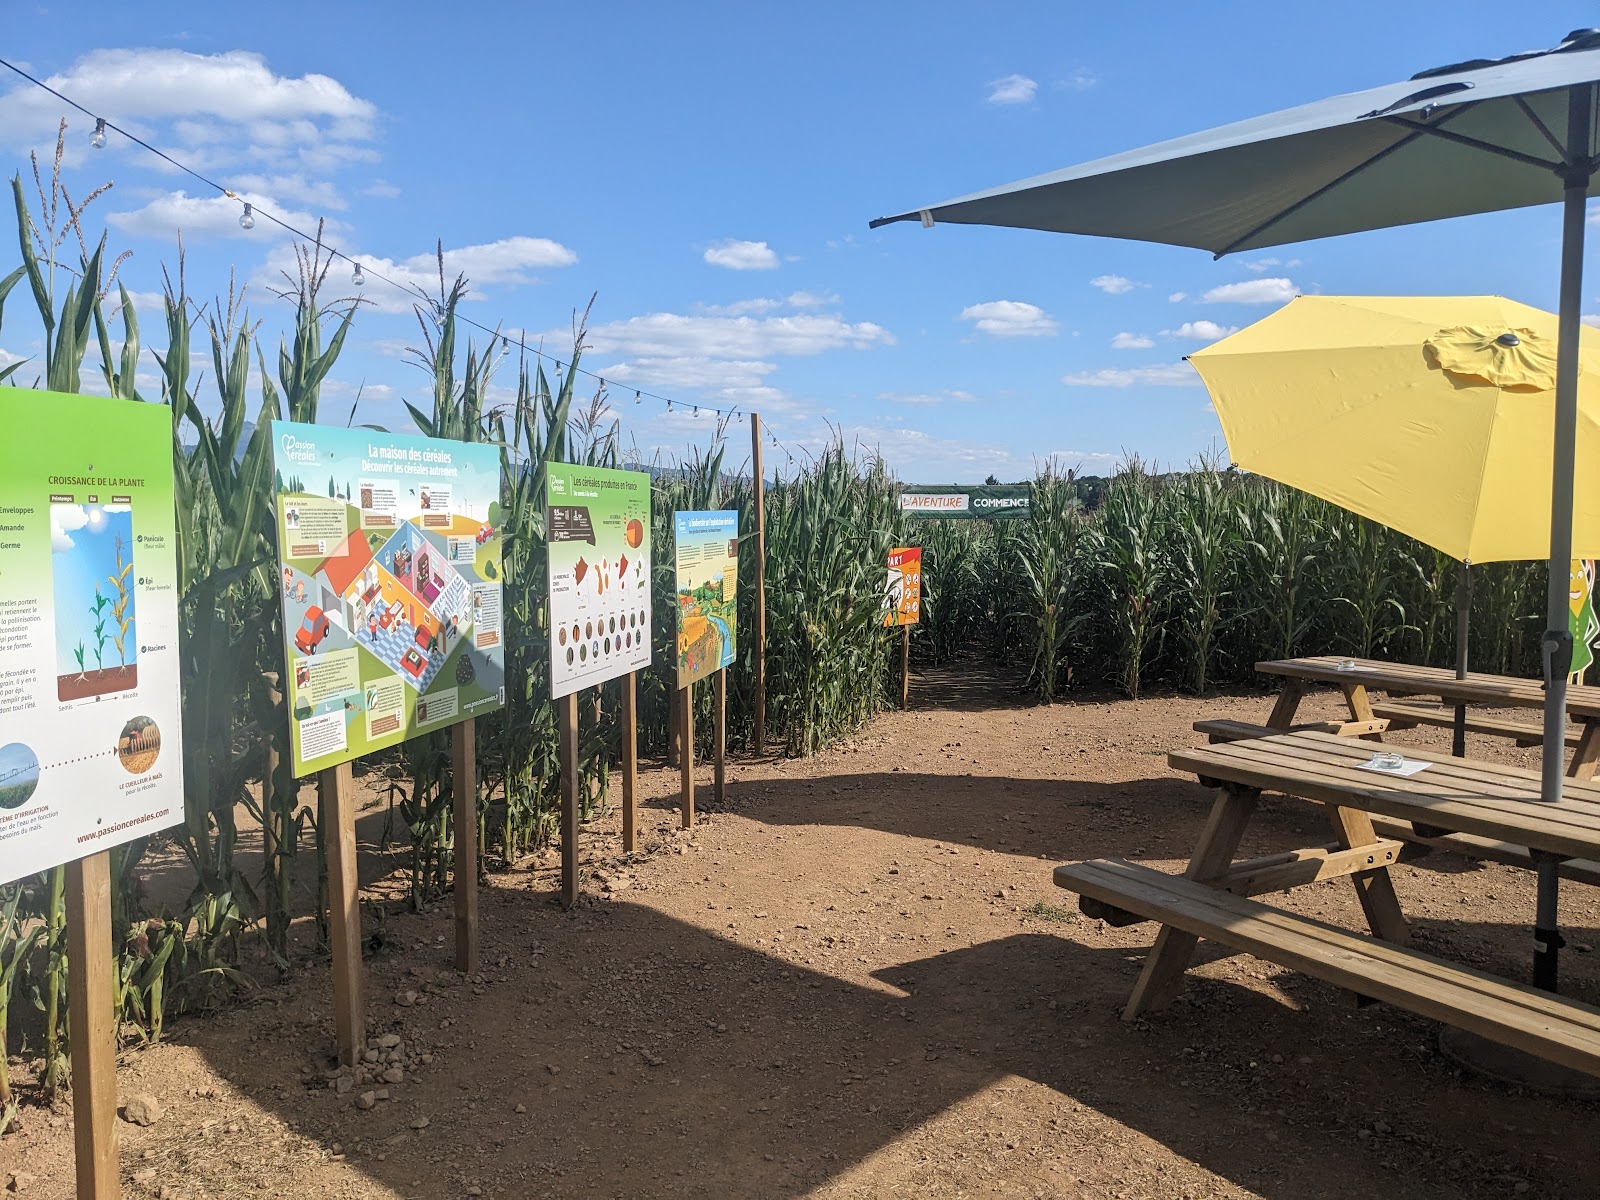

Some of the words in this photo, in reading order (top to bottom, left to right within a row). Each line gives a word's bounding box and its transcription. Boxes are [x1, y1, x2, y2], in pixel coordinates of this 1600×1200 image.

[287, 435, 316, 450] Passion
[368, 443, 378, 458] La
[379, 444, 408, 460] maison
[408, 447, 422, 462] des
[423, 448, 452, 464] céréales
[362, 459, 394, 473] Découvrir
[394, 461, 404, 474] les
[404, 462, 429, 475] céréales
[429, 465, 458, 478] autrement
[49, 476, 95, 486] CROISSANCE
[97, 478, 107, 486] DE
[109, 478, 118, 487] LA
[119, 479, 145, 488] PLANTE
[573, 476, 581, 486] Les
[581, 476, 600, 488] céréales
[600, 478, 620, 490] produites
[620, 482, 626, 490] en
[625, 480, 638, 490] France
[903, 497, 963, 507] L'AVENTURE
[973, 498, 1030, 508] COMMENCE
[0, 506, 35, 516] Enveloppes
[0, 524, 25, 532] Amande
[58, 704, 74, 712] Semis
[14, 805, 49, 820] D'IRRIGATION
[37, 811, 59, 821] fonction
[77, 808, 170, 844] www.passioncereales.com
